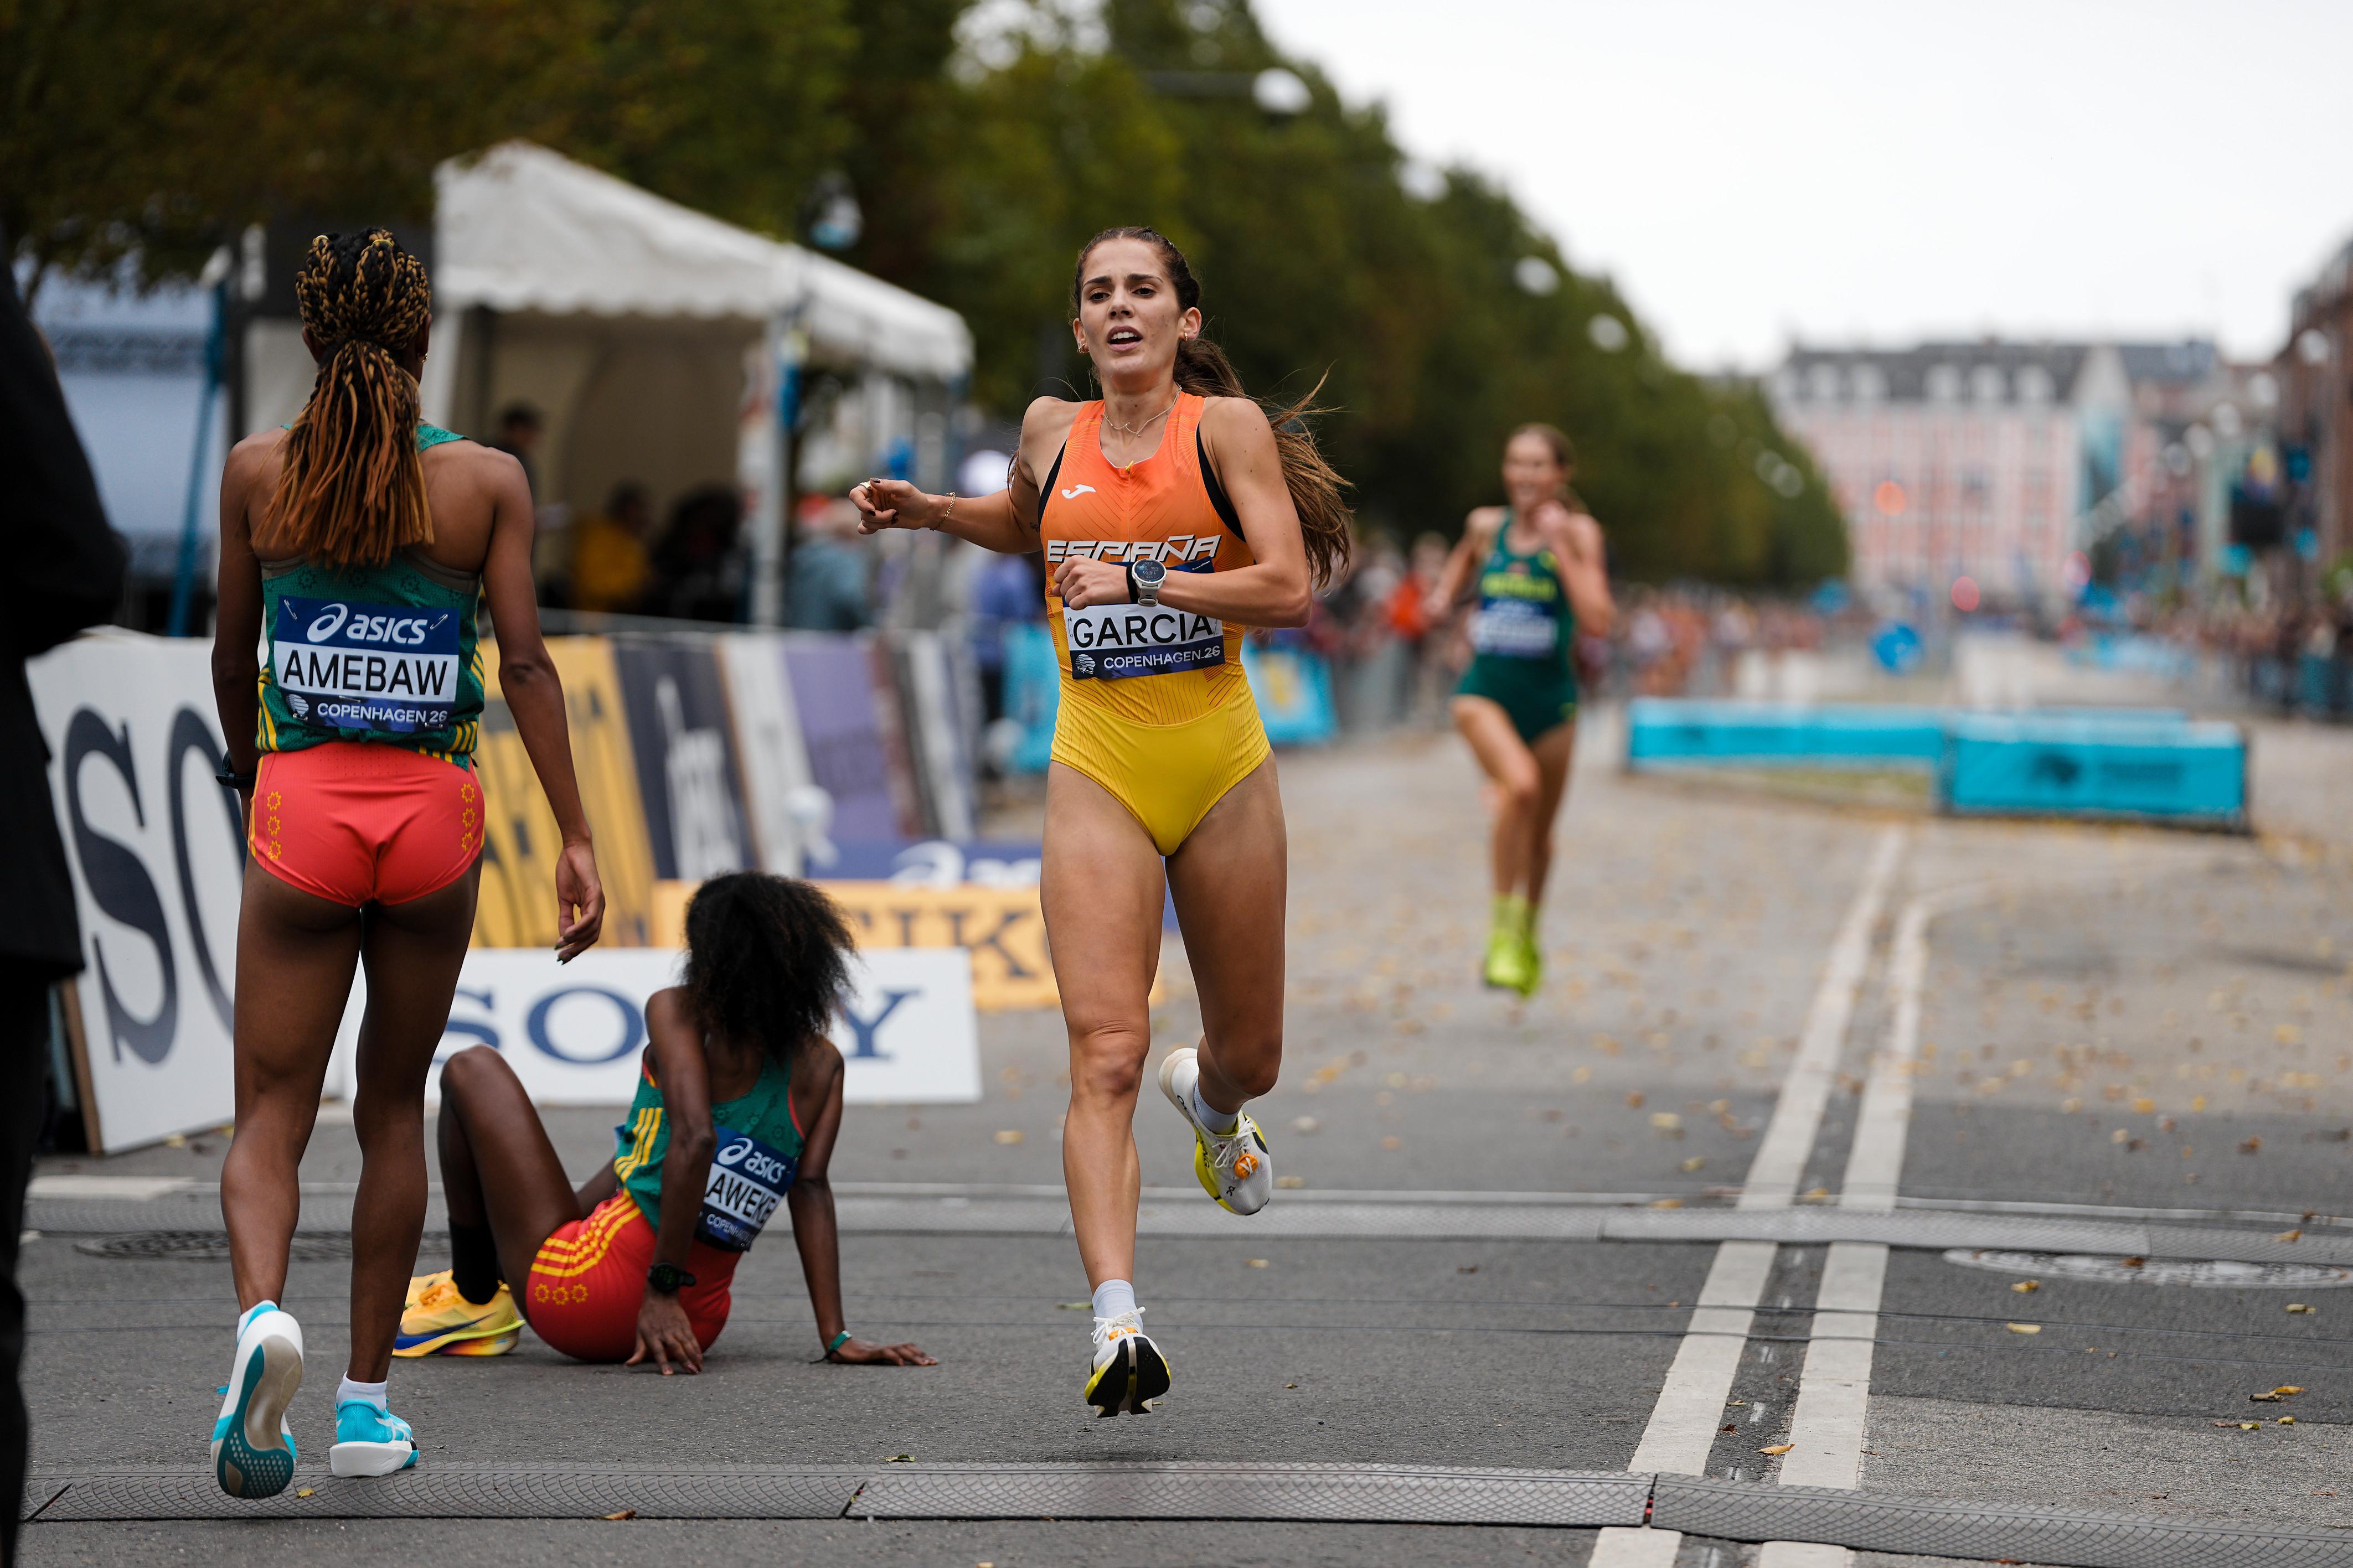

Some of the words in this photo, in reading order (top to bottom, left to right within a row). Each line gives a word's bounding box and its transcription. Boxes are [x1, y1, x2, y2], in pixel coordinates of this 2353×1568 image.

[1047, 535, 1222, 563] ESPAÑA
[1103, 649, 1200, 669] COPENHAGEN
[1204, 645, 1220, 659] 26
[283, 649, 448, 696] AMEBAW
[317, 702, 427, 723] COPENHAGEN
[429, 710, 448, 723] 26
